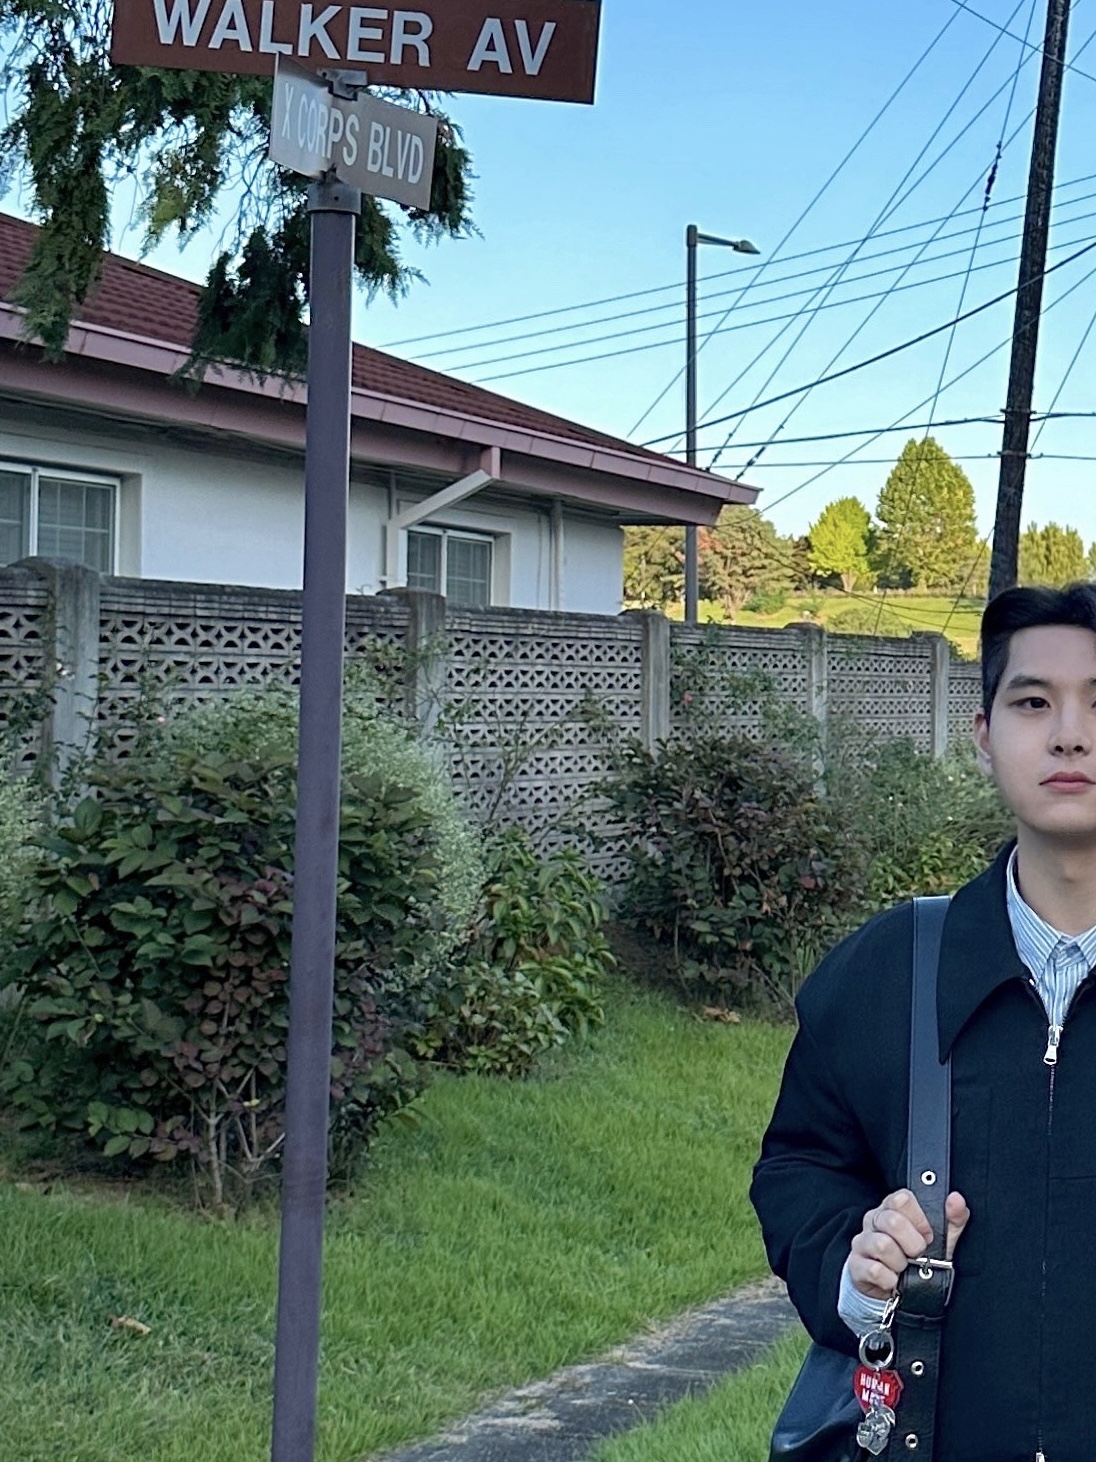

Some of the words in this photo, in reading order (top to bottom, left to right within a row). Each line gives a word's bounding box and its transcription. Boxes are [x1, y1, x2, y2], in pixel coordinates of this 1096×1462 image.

[153, 0, 434, 67] WALKER
[466, 18, 557, 76] AV
[281, 82, 294, 141] X
[297, 93, 360, 167] CORPS
[366, 121, 425, 185] BLVD
